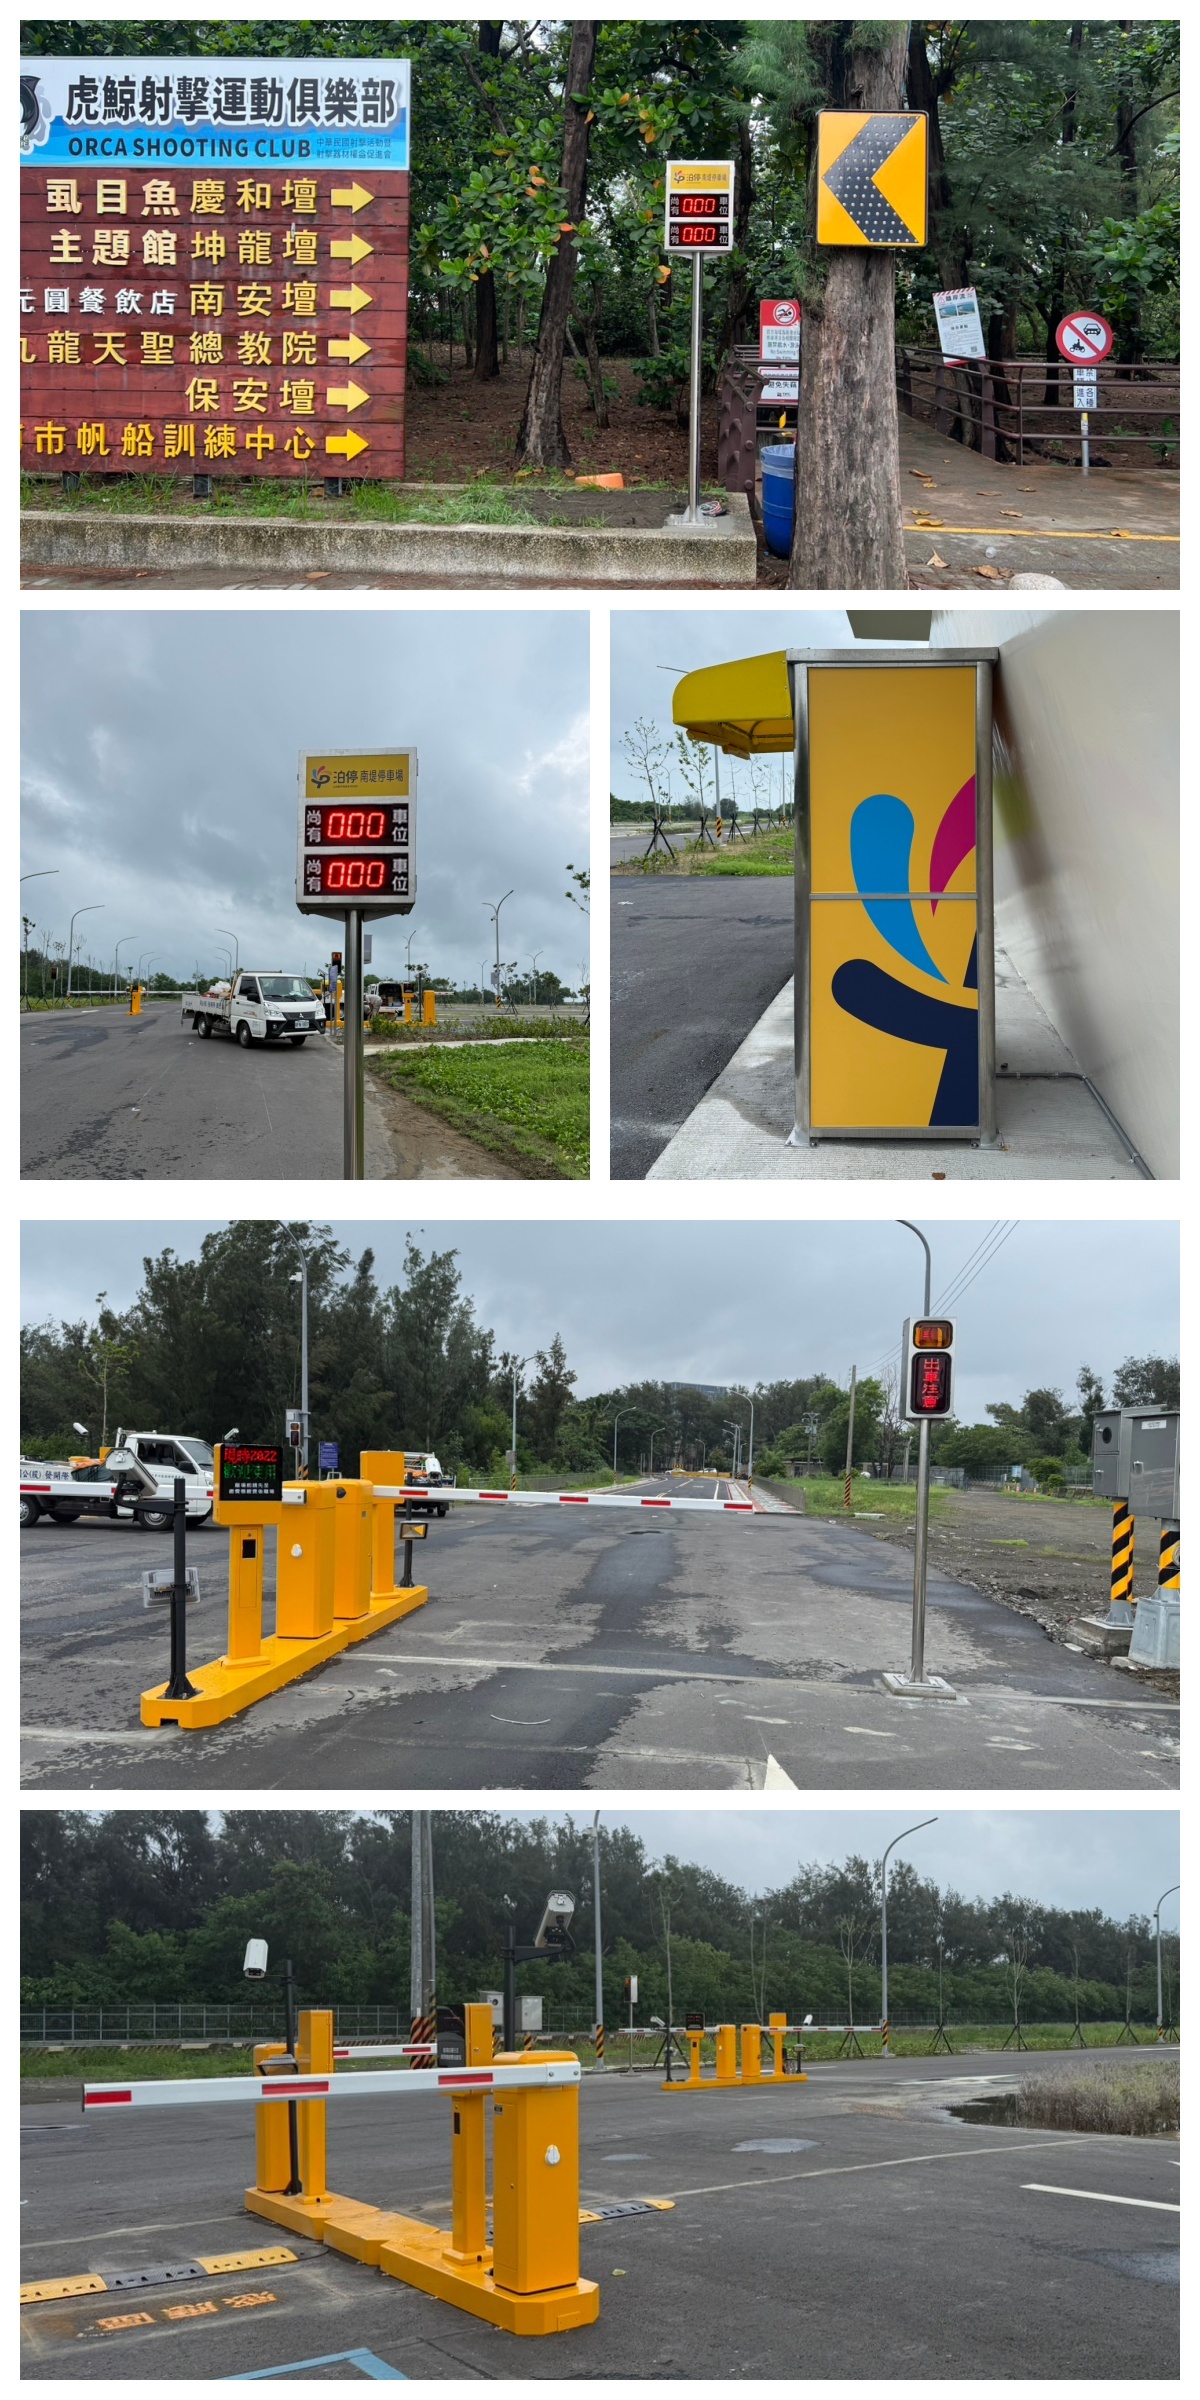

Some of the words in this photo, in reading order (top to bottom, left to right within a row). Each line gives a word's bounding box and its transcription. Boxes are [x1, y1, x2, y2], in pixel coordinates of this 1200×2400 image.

[65, 75, 396, 123] 虎鯨射擊運動俱樂部
[68, 136, 128, 157] ORCA
[133, 137, 249, 158] SHOOTING
[254, 138, 312, 158] CLUB
[46, 178, 181, 217] 虱目魚
[190, 177, 318, 215] 慶和壇
[682, 198, 716, 213] 000
[49, 228, 178, 266] 主題館
[190, 228, 319, 266] 坤龍壇
[682, 227, 716, 242] 000
[189, 280, 318, 318] 南安壇
[185, 377, 316, 415] 保安壇
[20, 421, 316, 461] 市帆船訓練中心
[333, 770, 358, 784] 泊停
[306, 810, 321, 843] 尚有
[327, 812, 385, 839] 000
[392, 808, 408, 843] 車位
[306, 859, 321, 893] 尚有
[327, 862, 385, 888] 000
[392, 858, 408, 892] 車位
[922, 1358, 939, 1408] 出車注意
